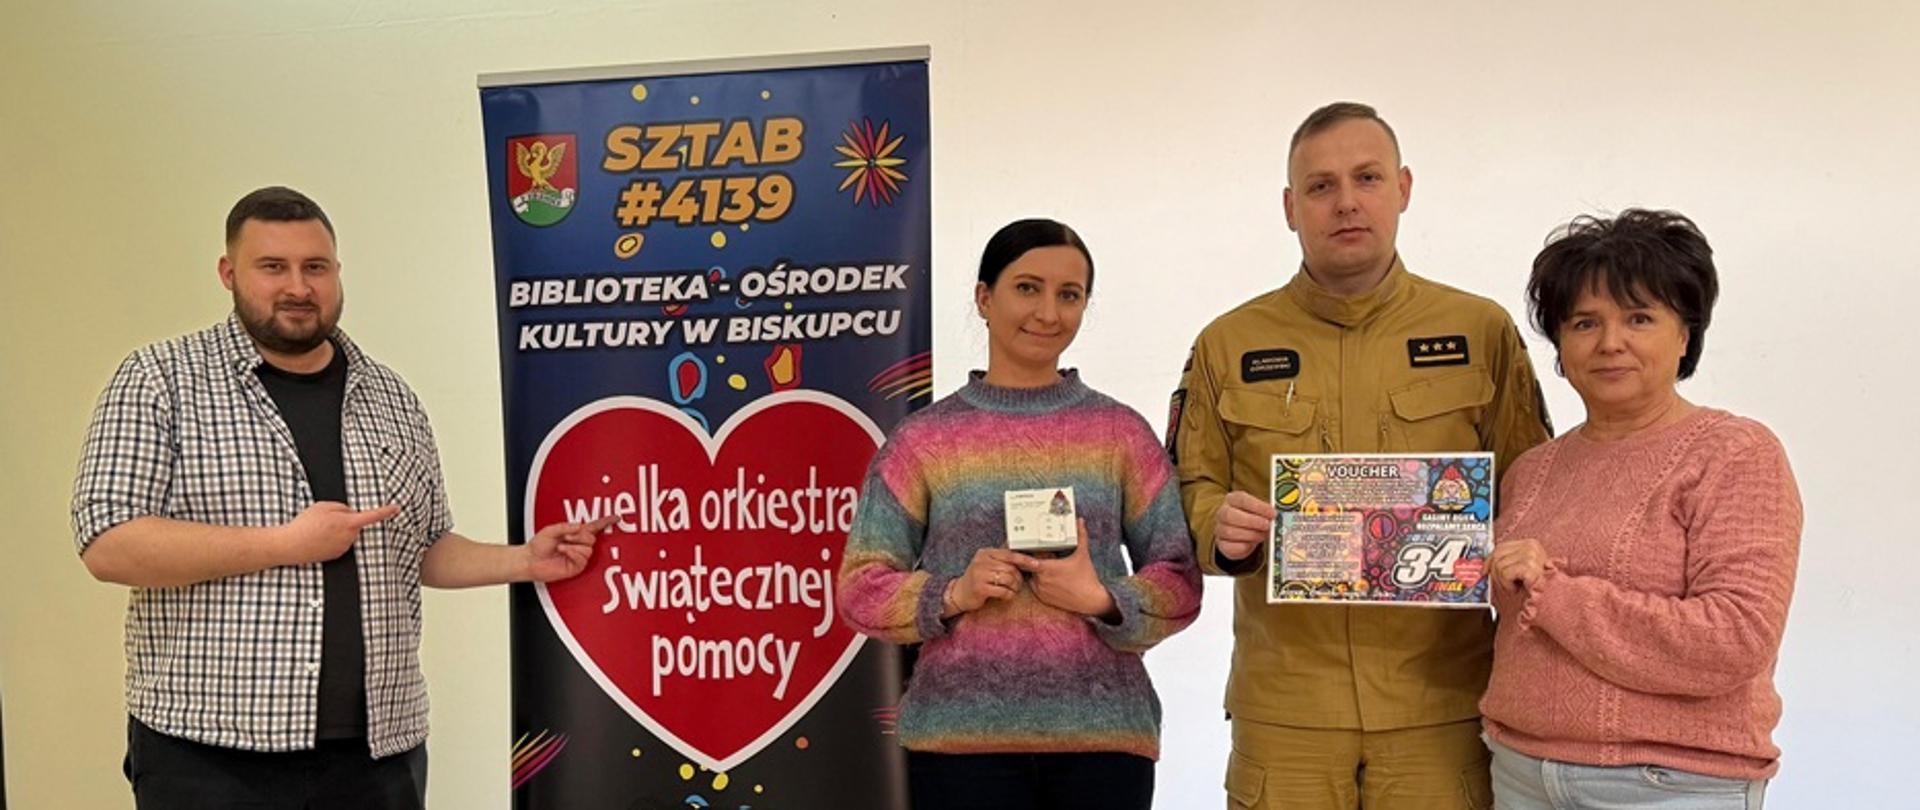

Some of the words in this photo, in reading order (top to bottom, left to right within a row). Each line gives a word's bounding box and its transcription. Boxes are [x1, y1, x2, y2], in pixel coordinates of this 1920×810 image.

[604, 117, 804, 171] SZTAB
[616, 174, 793, 226] #4139
[509, 274, 708, 307] BIBLIOTEKA
[740, 264, 909, 298] OŚRODEK
[519, 320, 674, 350] KULTURY
[682, 318, 719, 343] W
[727, 310, 901, 342] BISKUPCU
[1327, 465, 1399, 479] VOUCHER
[564, 463, 690, 533] wielka
[701, 466, 858, 535] orkiestra
[1395, 539, 1468, 585] 34
[602, 544, 834, 639] świątecznej
[652, 633, 800, 700] pomocy
